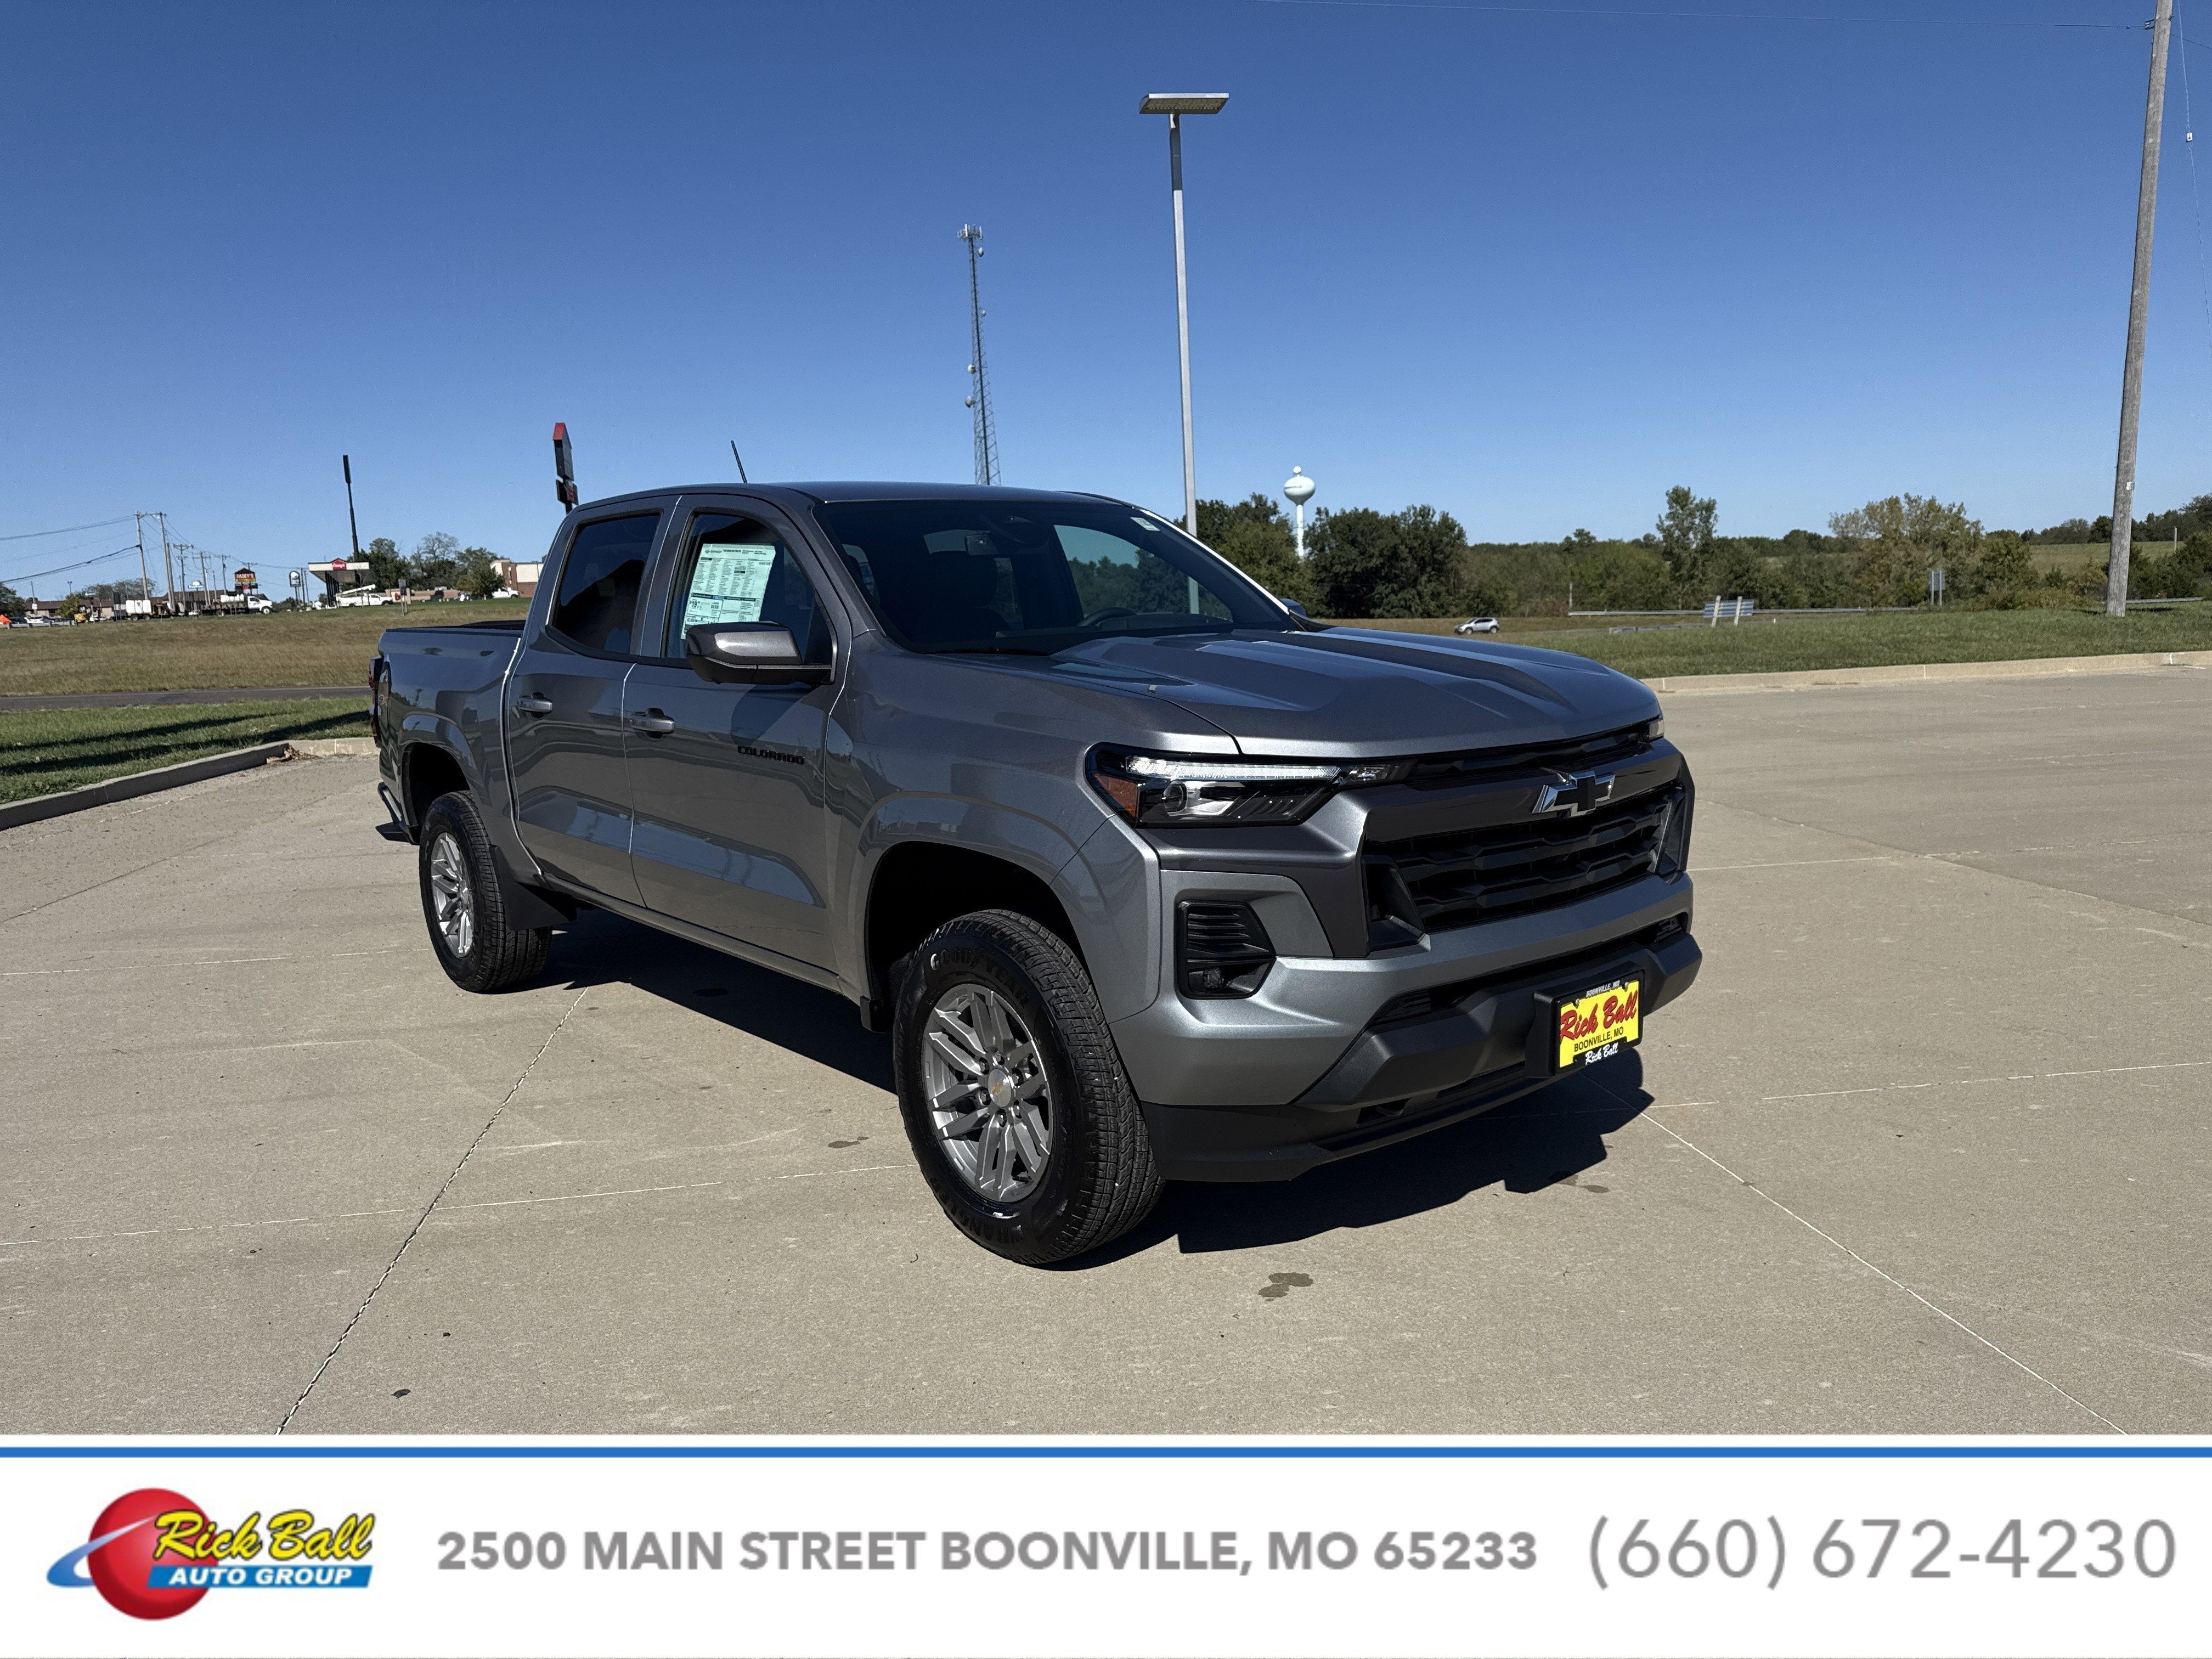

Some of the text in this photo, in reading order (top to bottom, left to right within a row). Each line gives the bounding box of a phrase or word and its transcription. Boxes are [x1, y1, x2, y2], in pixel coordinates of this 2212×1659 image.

[737, 746, 804, 765] COLORADO
[1585, 980, 1620, 997] BOONVILLE, MO
[1560, 990, 1638, 1044] Rick Ball
[1575, 1026, 1624, 1052] BOONVILLE, MO
[1585, 1042, 1619, 1065] Rick Ball
